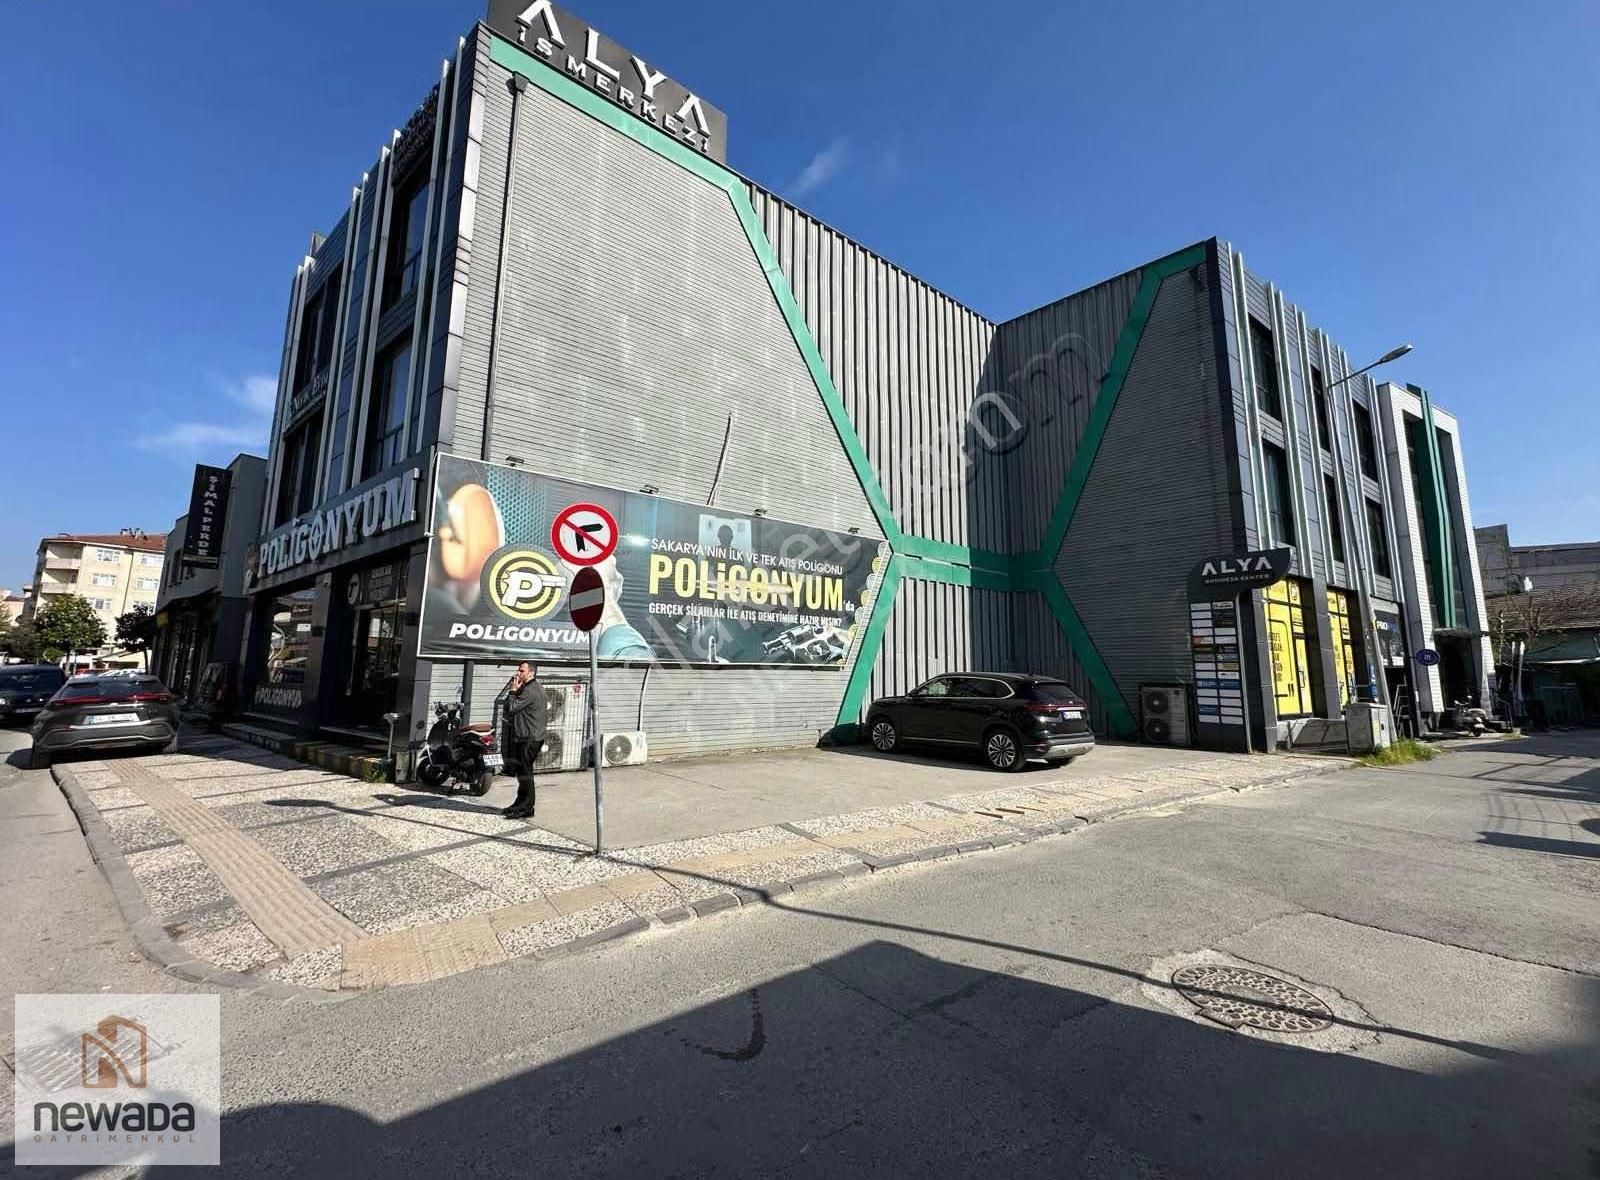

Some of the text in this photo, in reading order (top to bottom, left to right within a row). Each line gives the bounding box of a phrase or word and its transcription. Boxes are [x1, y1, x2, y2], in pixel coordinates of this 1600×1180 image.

[516, 0, 711, 136] ALYA
[651, 538, 727, 559] SAKARYA'NIN
[729, 546, 743, 561] İLK
[746, 552, 759, 563] VE
[760, 554, 776, 566] TEK
[779, 556, 797, 570] ATIŞ
[1201, 556, 1273, 576] ALYA
[648, 602, 684, 618] GERÇEK
[726, 606, 739, 620] İLE
[740, 610, 757, 624] ATIŞ
